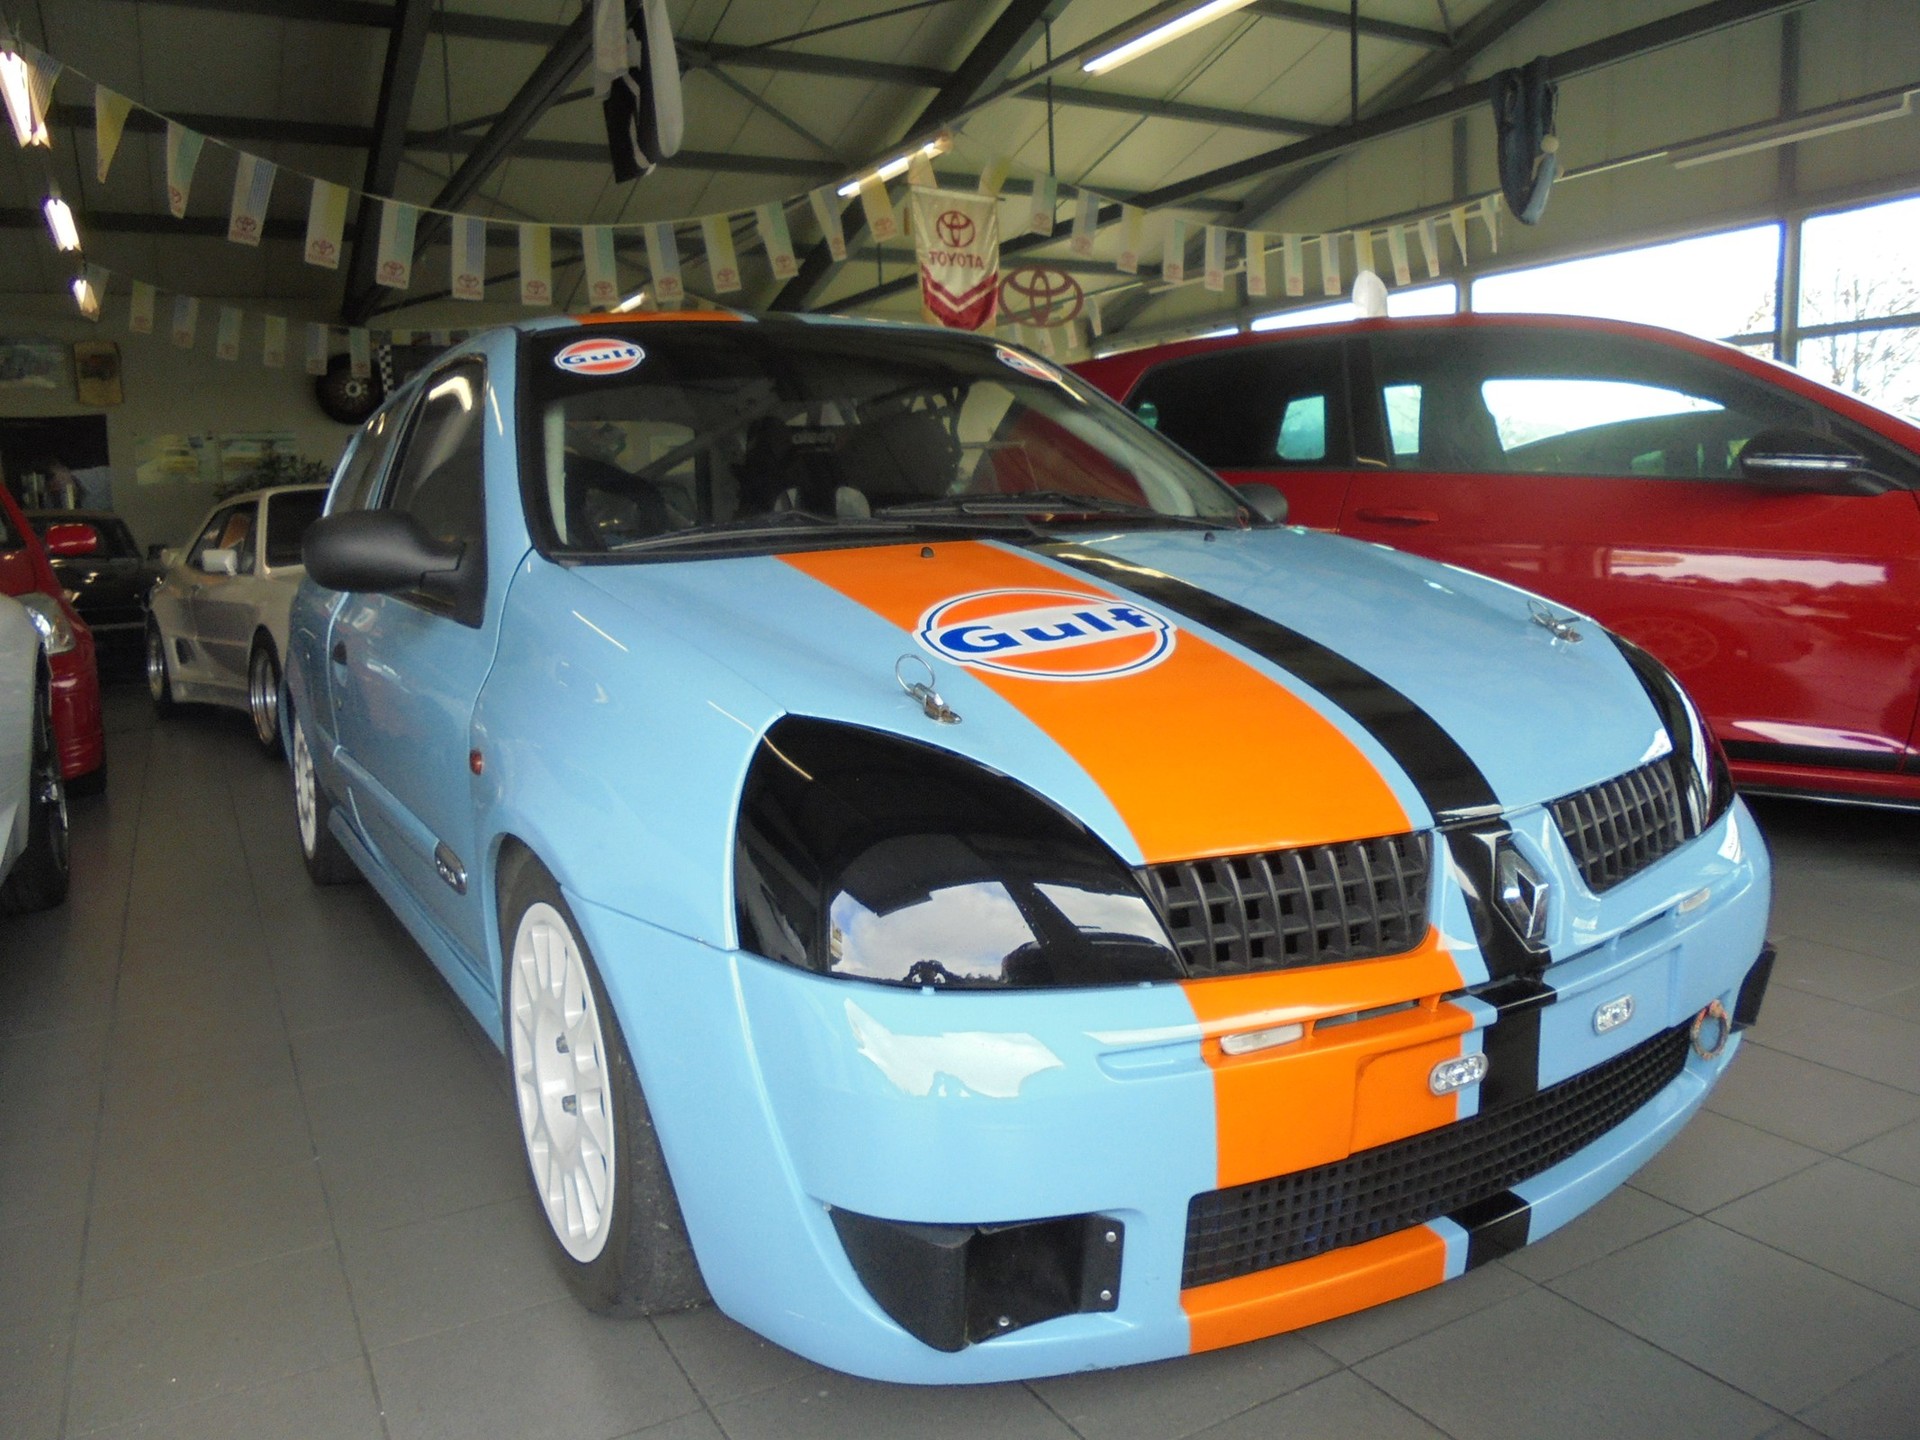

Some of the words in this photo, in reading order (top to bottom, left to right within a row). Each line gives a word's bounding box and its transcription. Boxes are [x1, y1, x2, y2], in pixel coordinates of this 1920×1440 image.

[929, 250, 984, 269] TOYOTA
[562, 348, 637, 365] Gulf
[939, 607, 1153, 653] Gulf
